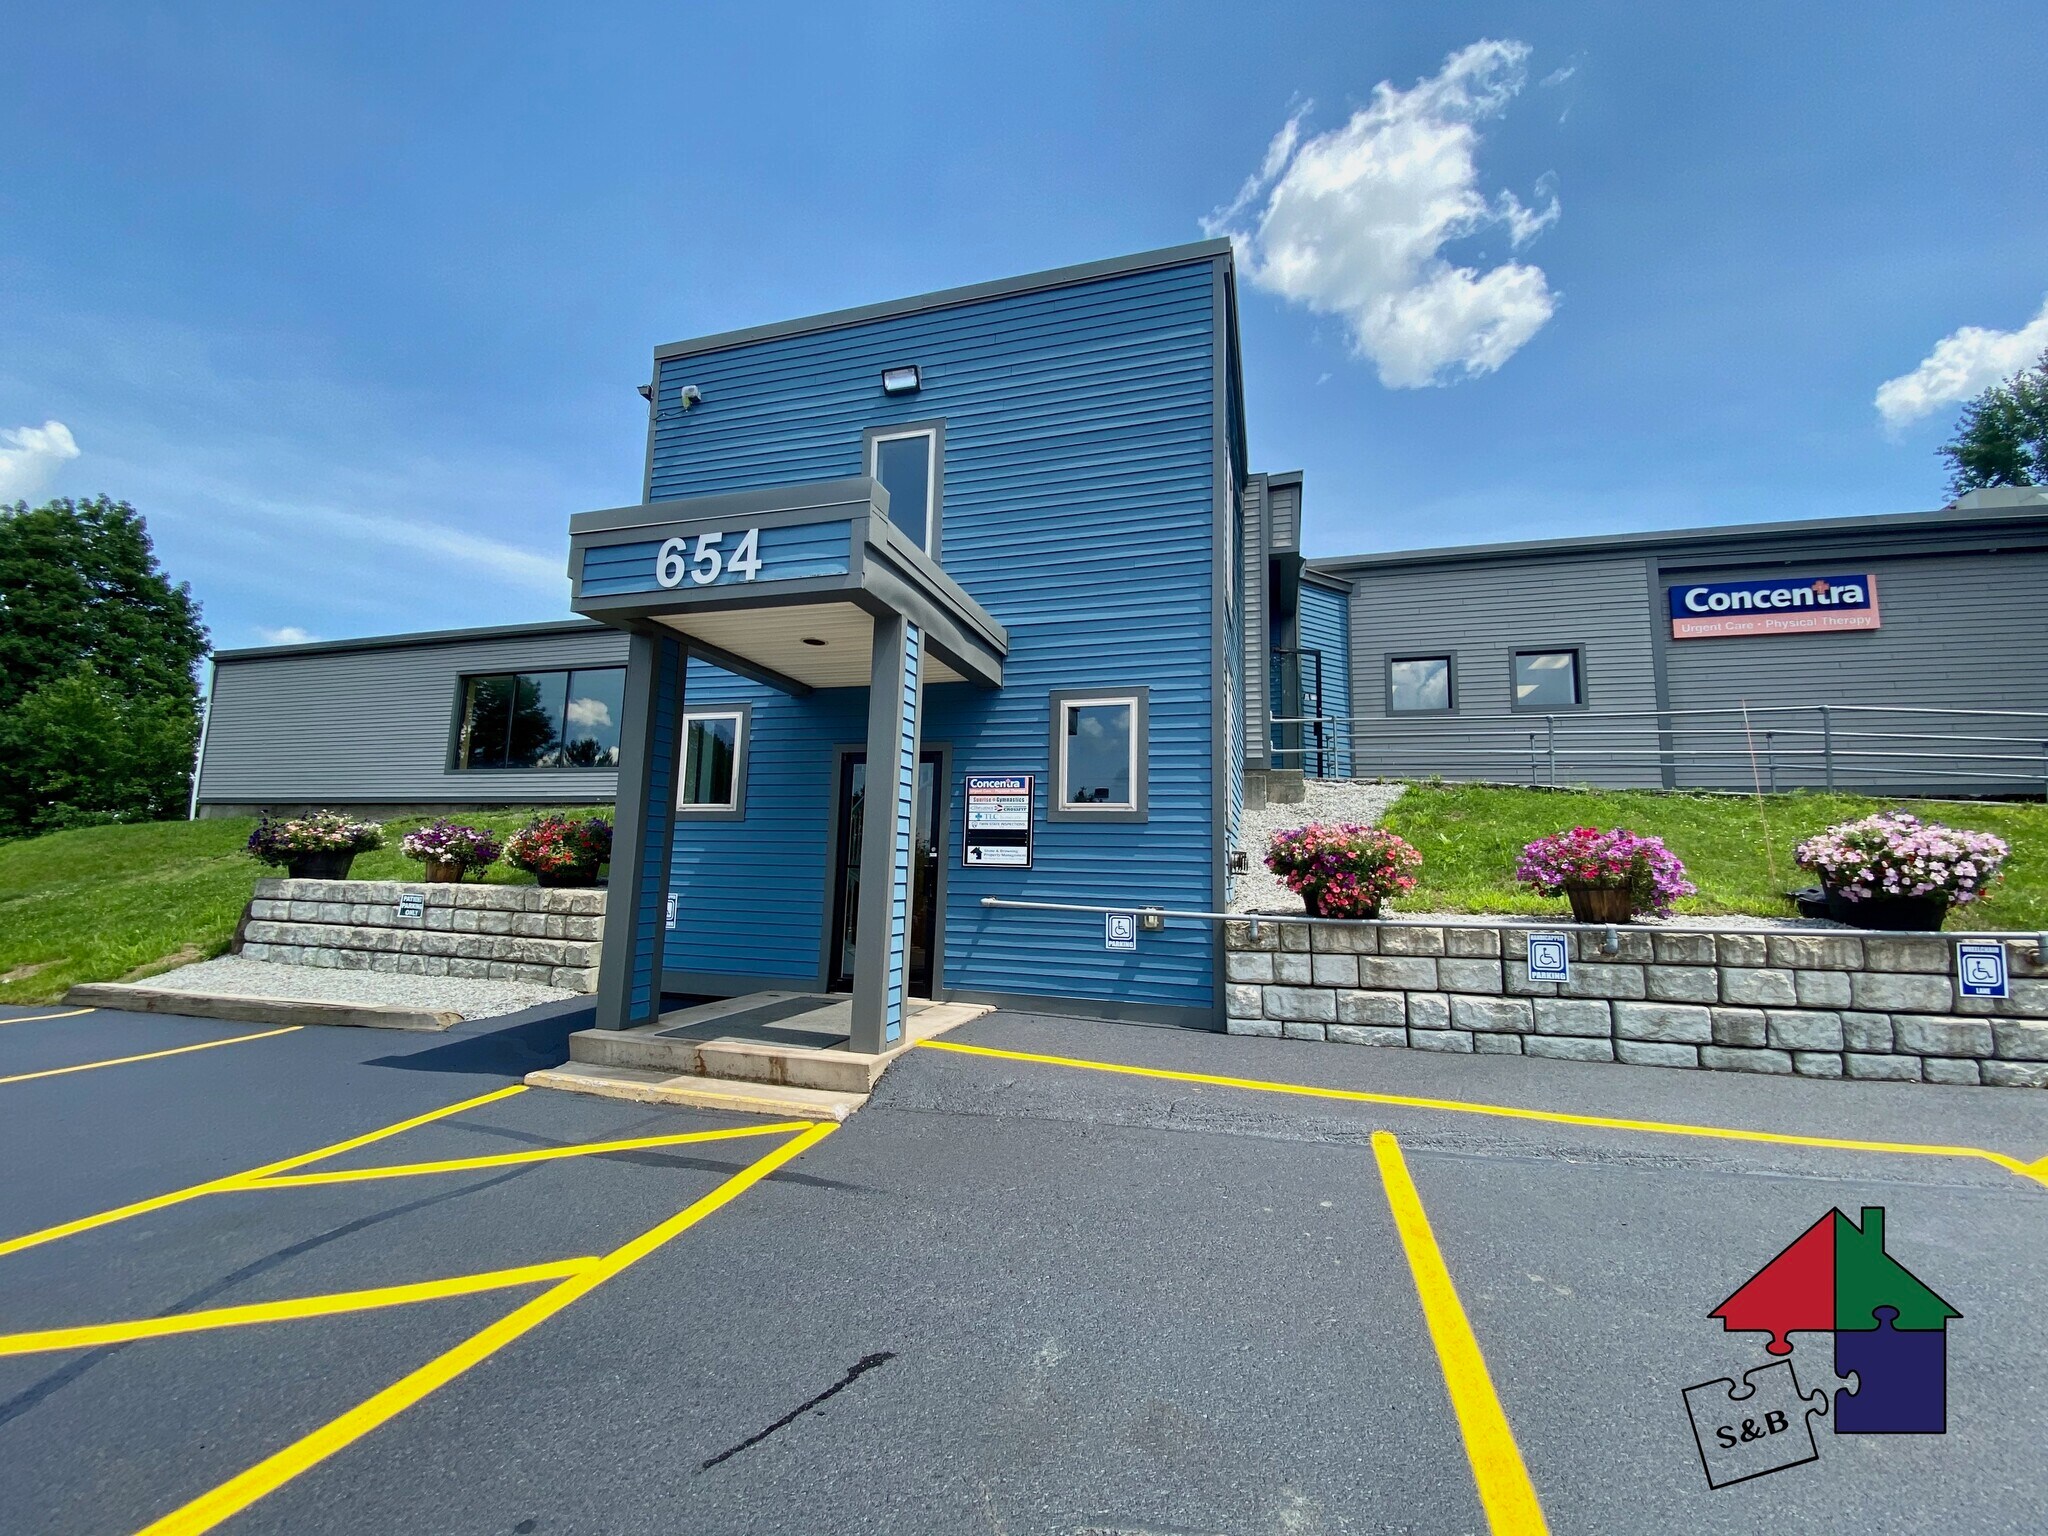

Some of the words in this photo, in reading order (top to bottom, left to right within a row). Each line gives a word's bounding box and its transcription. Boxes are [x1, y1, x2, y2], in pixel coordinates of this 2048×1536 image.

[656, 528, 762, 588] 654
[1685, 580, 1864, 612] Concentra
[1681, 623, 1722, 634] Urgent
[1725, 621, 1754, 631] Care
[1766, 616, 1818, 629] Physical
[1821, 616, 1871, 627] Therapy
[970, 778, 1020, 788] Concentra
[1108, 940, 1134, 948] PARKING
[1531, 971, 1566, 980] PARKING
